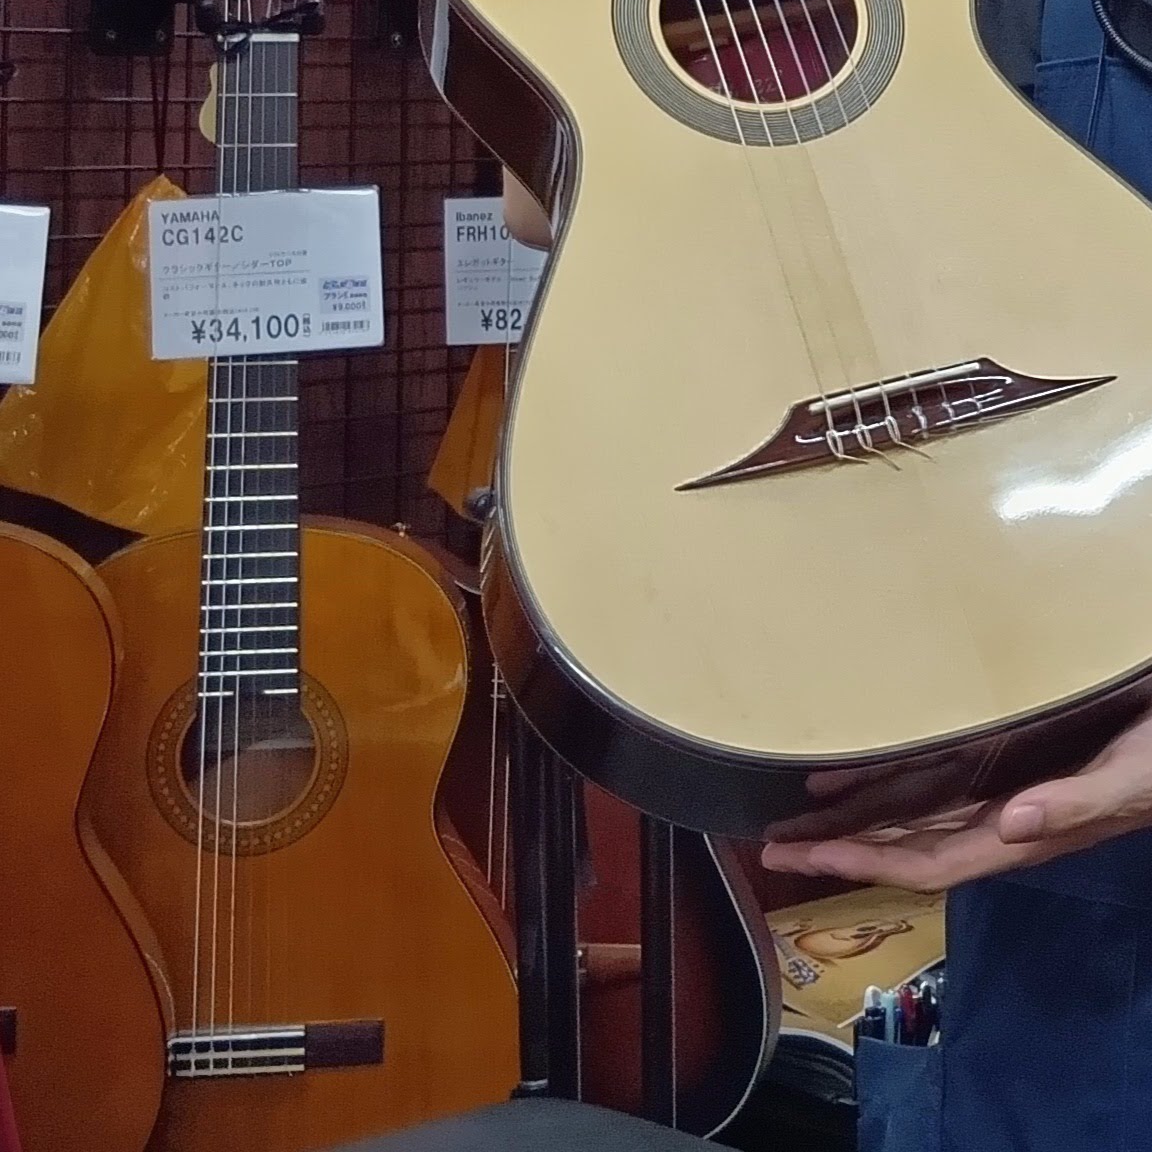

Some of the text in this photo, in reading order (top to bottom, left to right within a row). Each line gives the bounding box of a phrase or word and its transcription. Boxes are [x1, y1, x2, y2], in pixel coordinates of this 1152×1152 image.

[161, 209, 220, 225] YAMAHA
[455, 211, 493, 222] Ibanez
[161, 226, 244, 247] CG142C
[191, 312, 300, 345] ¥34,100
[481, 308, 522, 331] ¥82
